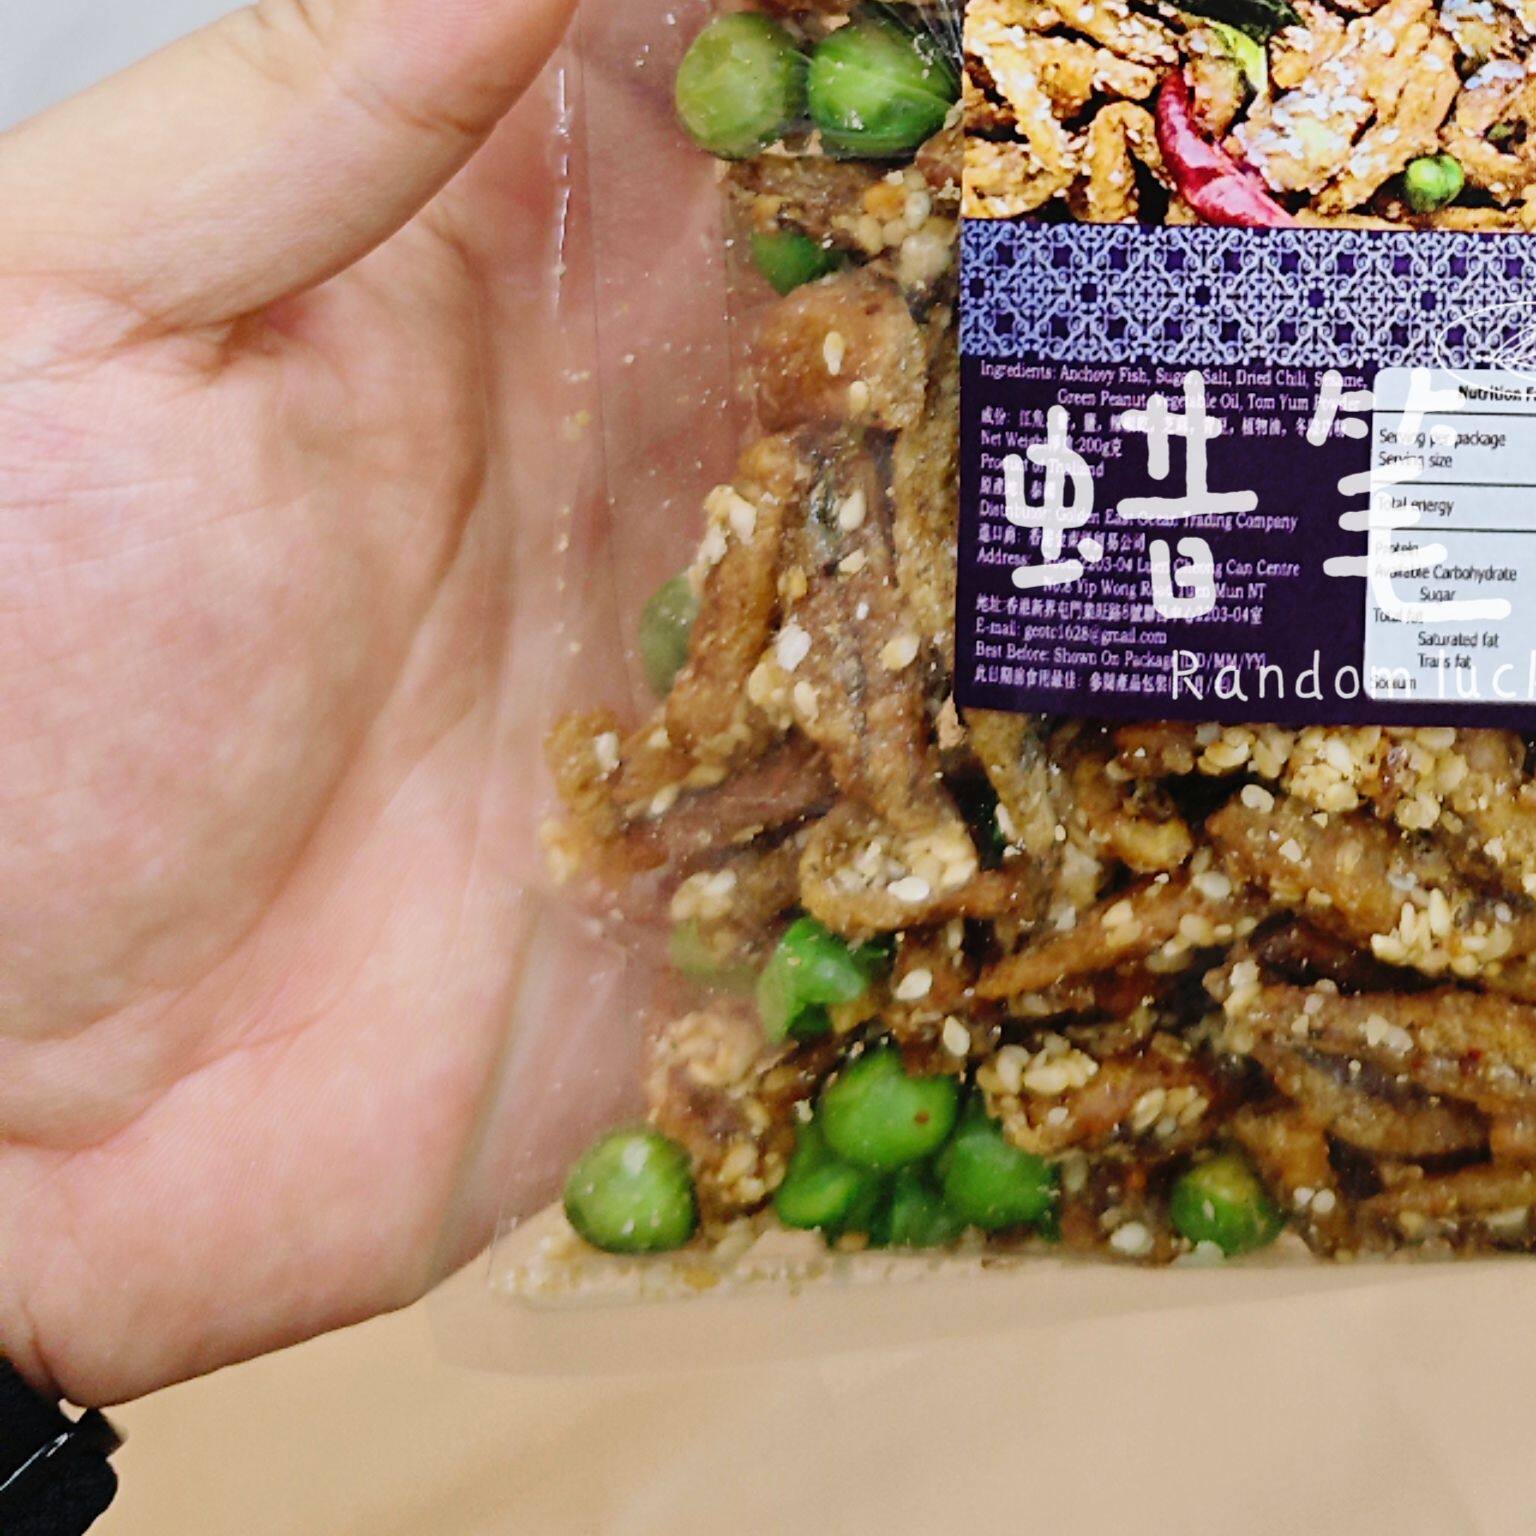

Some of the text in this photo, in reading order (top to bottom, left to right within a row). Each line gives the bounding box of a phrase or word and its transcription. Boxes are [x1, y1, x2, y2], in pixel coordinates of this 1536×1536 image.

[981, 361, 1056, 380] Ingredients:
[1060, 364, 1114, 386] Anchovy
[1119, 367, 1150, 386] Fish,
[1156, 367, 1200, 387] Suga
[1236, 369, 1271, 386] Dried
[1275, 369, 1309, 387] Chili,
[1314, 371, 1367, 389] Sme,
[1057, 388, 1096, 405] Green
[1220, 394, 1243, 412] Oil,
[1248, 395, 1274, 410] Tom
[1279, 395, 1308, 411] Yum
[1459, 386, 1521, 402] Nutrition
[981, 430, 1001, 446] Net
[1380, 429, 1425, 448] Serg
[1455, 431, 1506, 449] package
[1429, 453, 1452, 468] size
[1184, 512, 1232, 531] Trading
[1236, 515, 1298, 533] Company
[1257, 559, 1300, 577] Centre
[1433, 564, 1517, 583] Carbohydrate
[1101, 578, 1136, 600] Wong
[1420, 586, 1456, 603] Sugar
[1418, 631, 1499, 648] Saturated fat
[976, 640, 1001, 658] Best
[1053, 647, 1098, 665] Shown
[1101, 649, 1119, 666] On
[1125, 650, 1175, 671] Packag
[1455, 653, 1472, 670] fat
